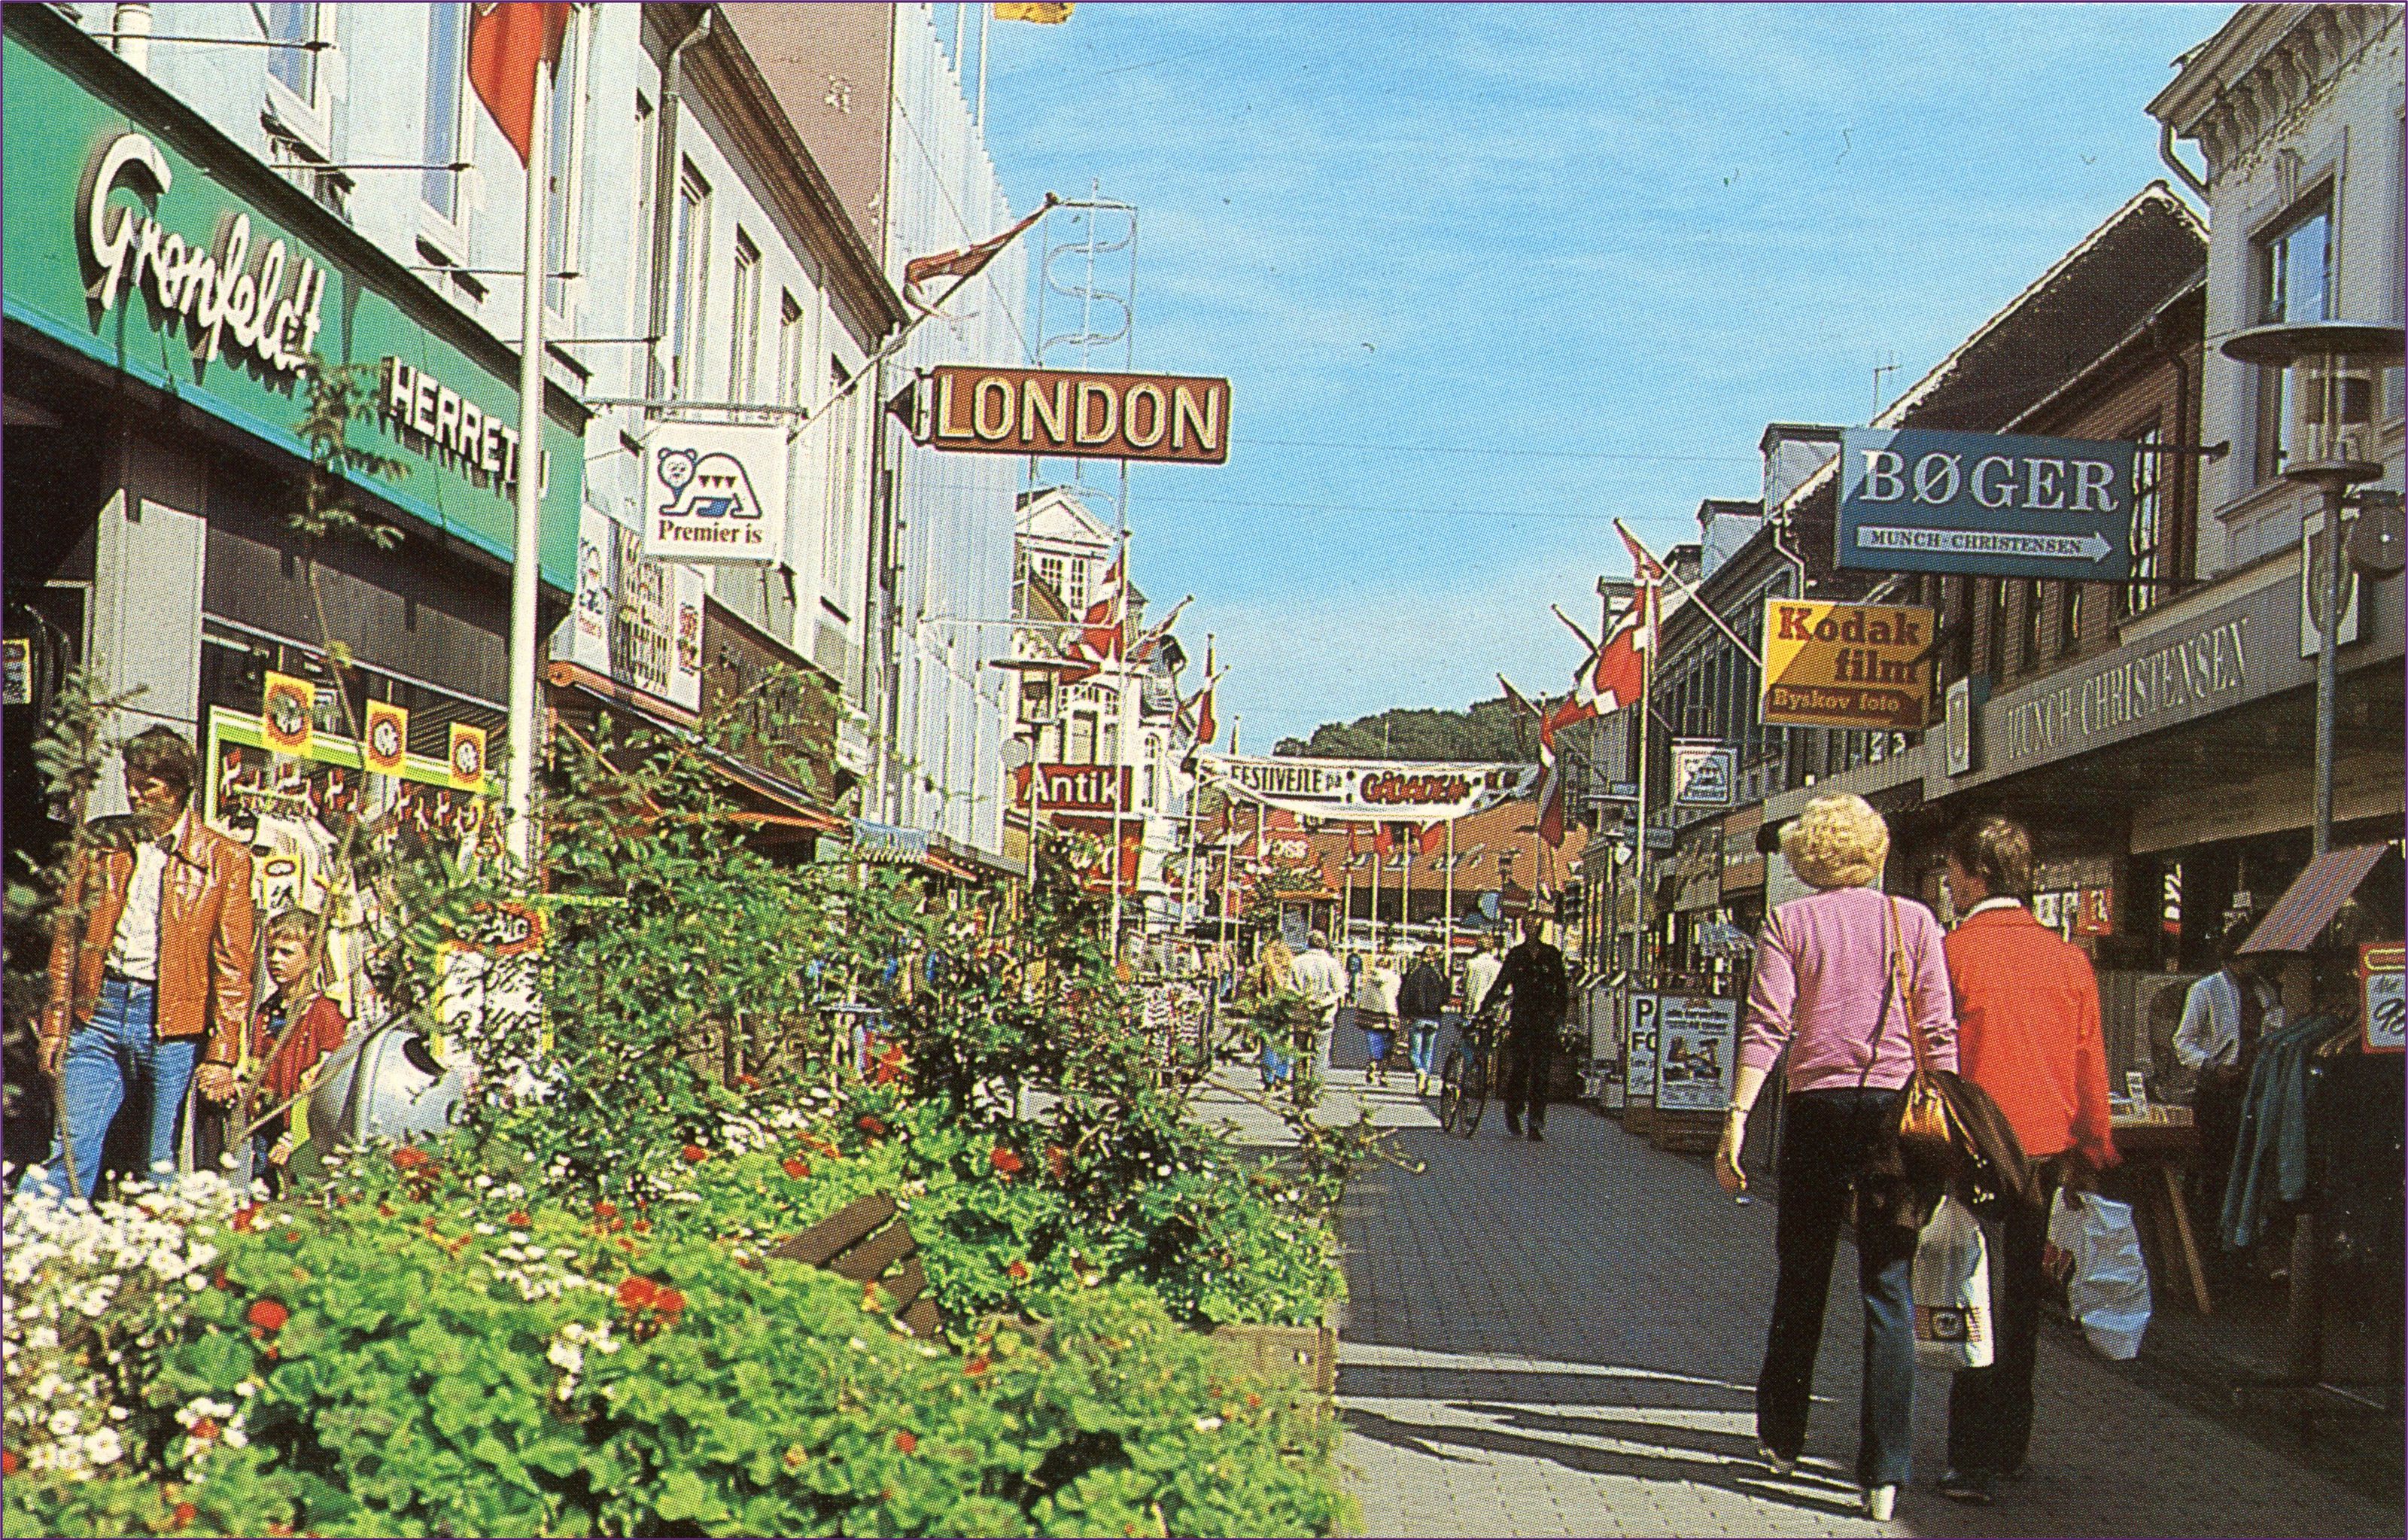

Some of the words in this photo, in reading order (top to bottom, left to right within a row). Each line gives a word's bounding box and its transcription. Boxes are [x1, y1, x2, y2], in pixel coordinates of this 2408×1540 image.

[389, 355, 551, 499] HERRETJ
[938, 374, 1221, 450] LONDON
[1859, 449, 2121, 513] BØGER
[657, 519, 741, 545] Premier
[744, 523, 763, 545] is
[1777, 606, 1920, 646] Kodak
[1834, 647, 1919, 684] film
[1772, 687, 1850, 711] Byskov
[1859, 690, 1901, 712] foto
[1023, 765, 1119, 803] Antik
